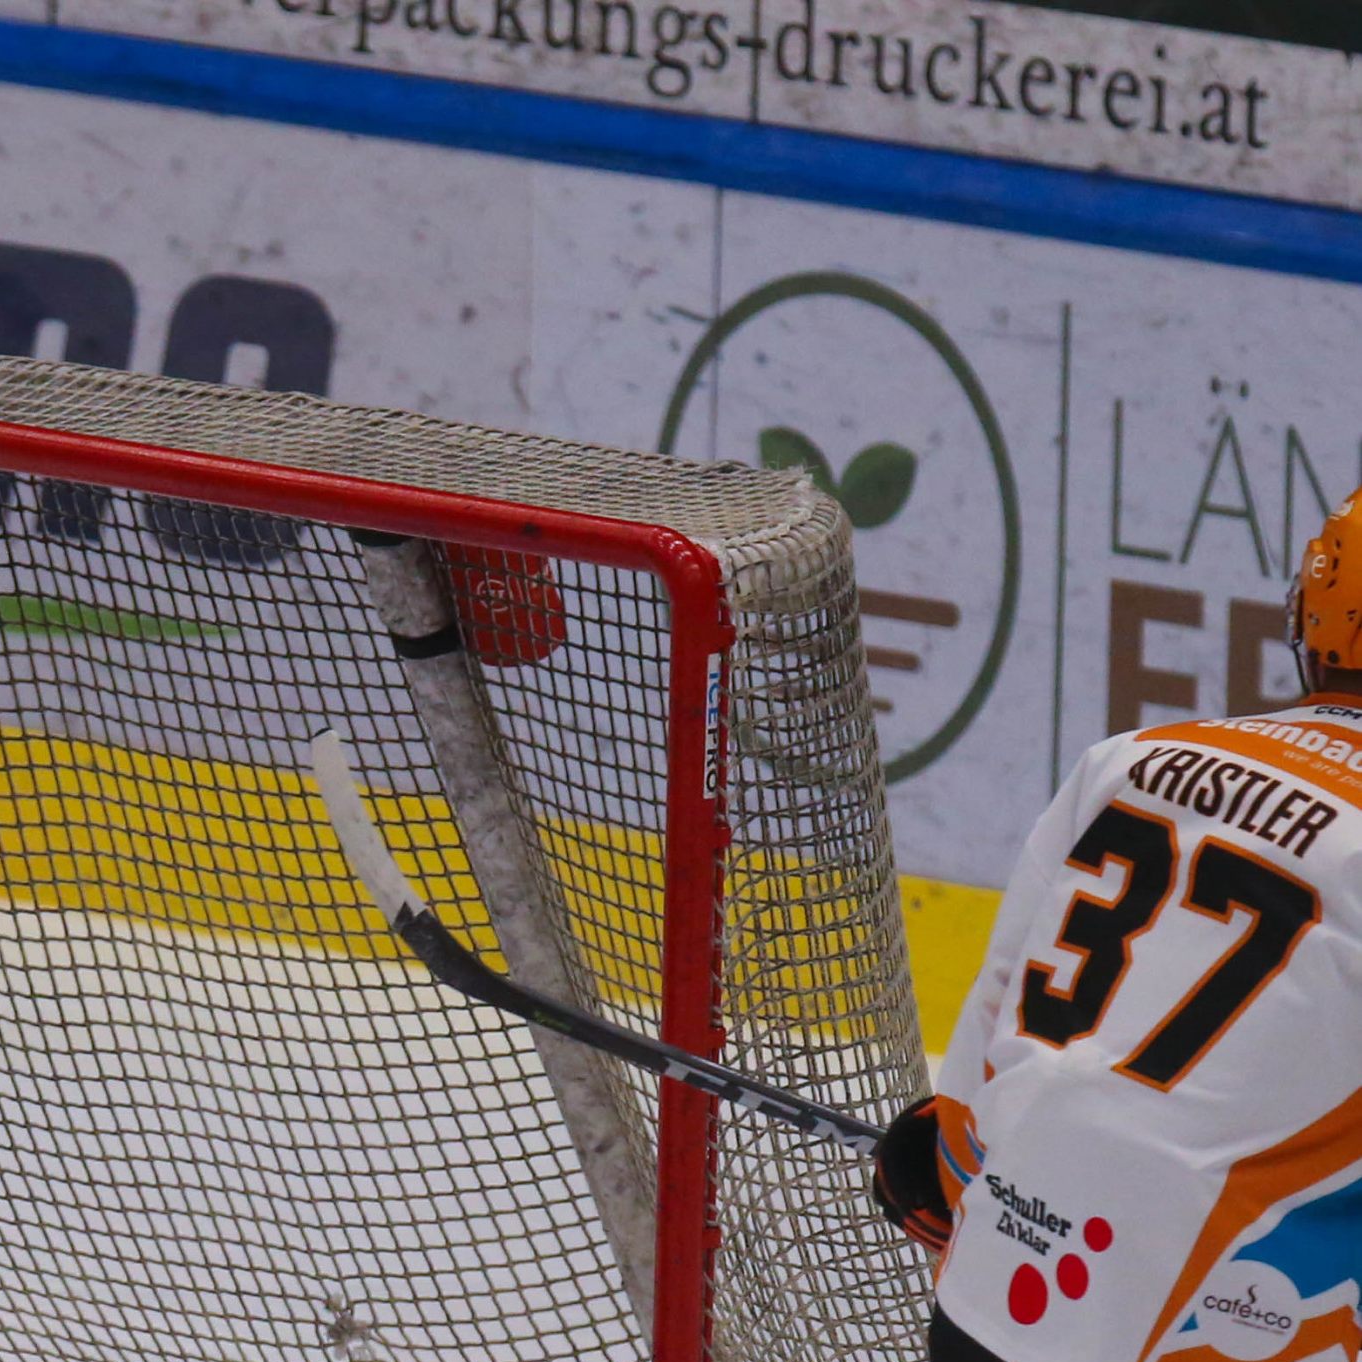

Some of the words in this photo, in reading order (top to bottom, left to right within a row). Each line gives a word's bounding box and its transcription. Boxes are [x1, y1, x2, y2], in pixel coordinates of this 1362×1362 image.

[277, 0, 1269, 149] packungs-druckerei.at
[706, 671, 720, 792] ICEPRO
[1128, 746, 1340, 858] KRISTLER
[1016, 799, 1323, 1093] 37
[985, 1174, 1072, 1238] Schuller
